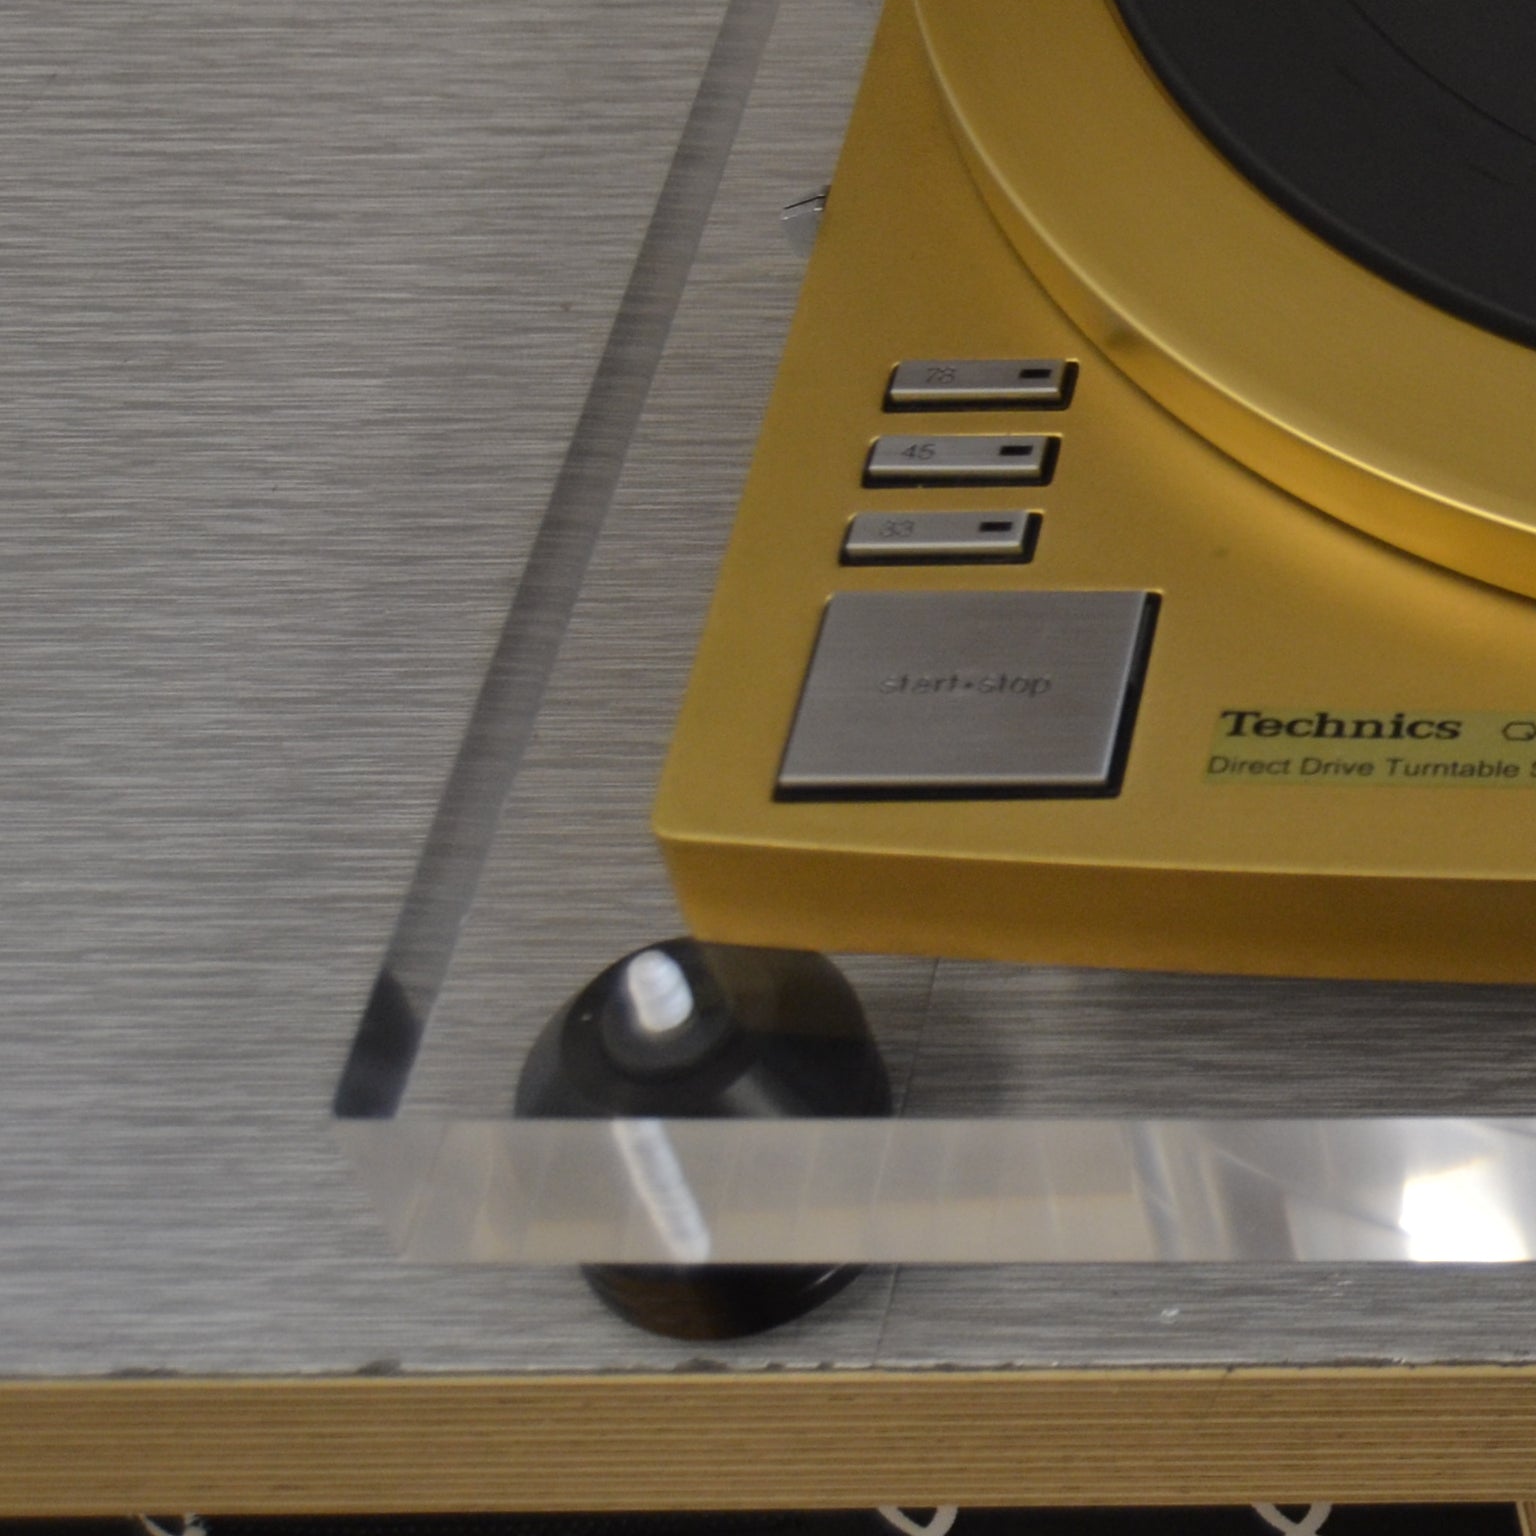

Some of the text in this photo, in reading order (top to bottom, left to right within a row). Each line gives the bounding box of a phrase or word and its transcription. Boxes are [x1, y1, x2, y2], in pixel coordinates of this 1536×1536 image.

[926, 367, 957, 384] 78
[901, 443, 936, 460] 45
[878, 520, 915, 537] 33
[1219, 710, 1463, 740] Technics
[1207, 755, 1290, 776] Direct
[1300, 757, 1375, 778] Drive
[1386, 757, 1519, 779] Turntable
